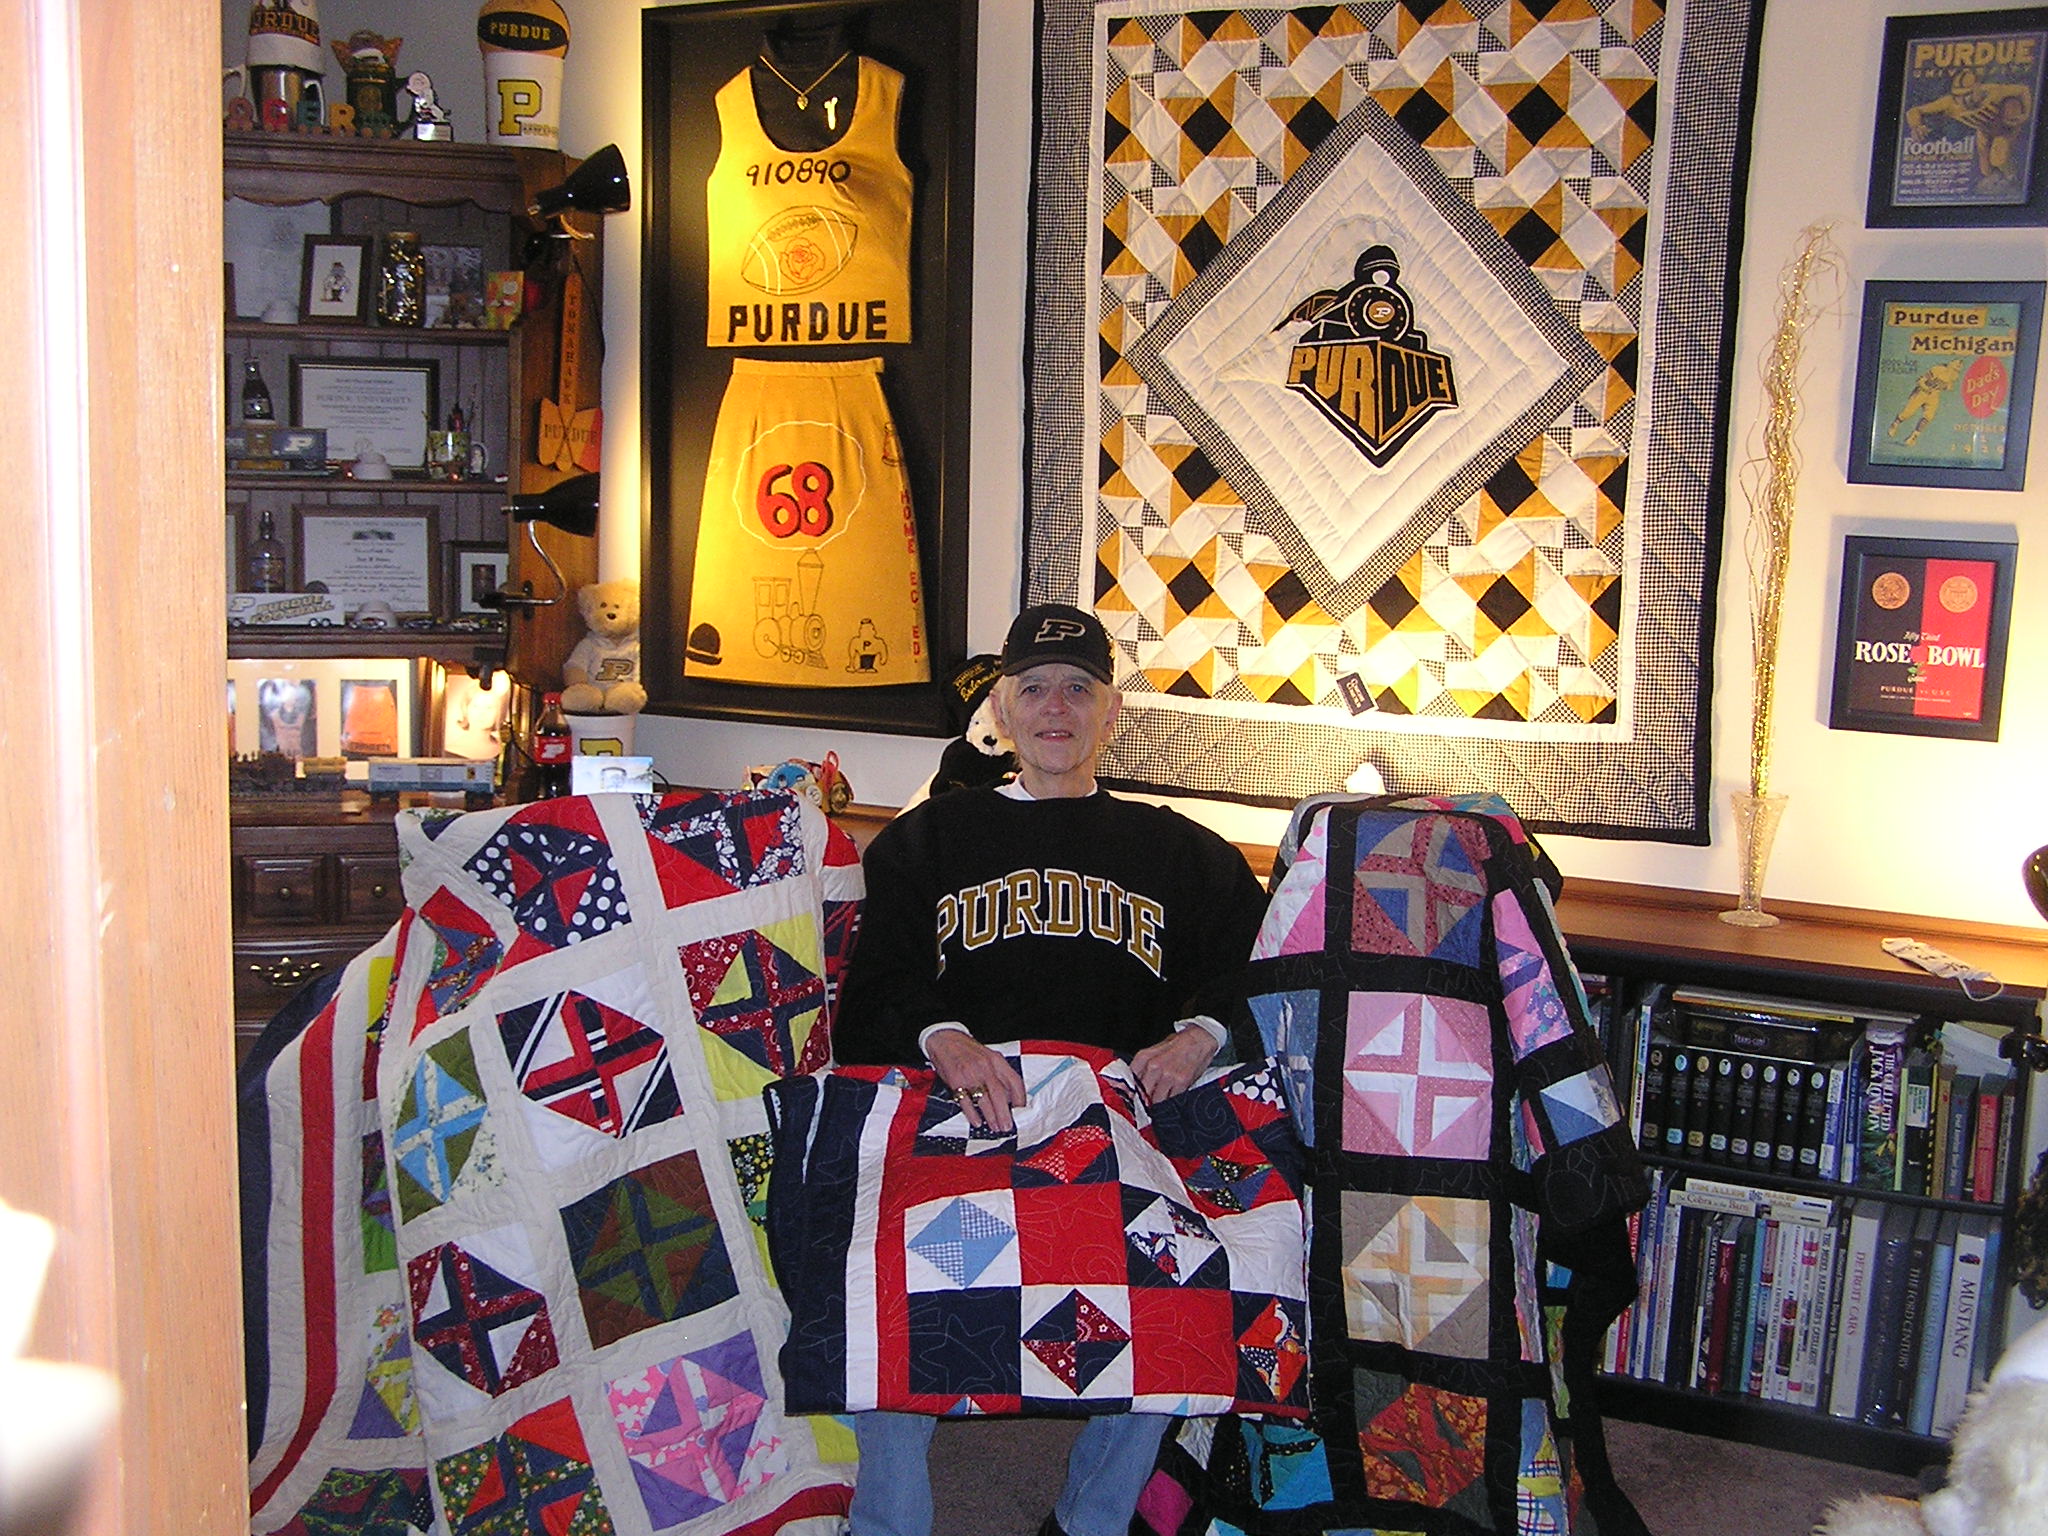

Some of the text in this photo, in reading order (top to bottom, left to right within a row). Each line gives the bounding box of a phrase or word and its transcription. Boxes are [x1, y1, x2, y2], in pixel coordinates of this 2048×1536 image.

[489, 22, 552, 41] PURDUE
[1914, 39, 2036, 69] PURDUE
[498, 79, 542, 136] P
[746, 157, 851, 187] 910890
[727, 300, 888, 343] PURDUE
[1373, 306, 1393, 318] P
[1893, 310, 1979, 325] Purdue
[1911, 336, 2014, 355] Michigan
[1288, 344, 1451, 440] PURDUE
[1966, 361, 2001, 393] Dad's
[1971, 386, 2001, 411] Day
[756, 461, 834, 539] 68
[1034, 619, 1086, 643] P
[1855, 640, 1986, 669] ROSE BOWL
[595, 658, 634, 682] P
[936, 867, 1167, 981] PURDUE
[1864, 1045, 1884, 1133] JACK LONDON
[1880, 1052, 1895, 1131] THE COLLECTED
[1821, 1232, 1831, 1246] THE
[1818, 1247, 1830, 1272] MODEL
[1772, 1286, 1782, 1313] LIONEL
[1845, 1250, 1866, 1336] DETROIT CARS
[1896, 1266, 1920, 1370] THE FORD CENTURY
[1949, 1278, 1978, 1359] MUSTANG
